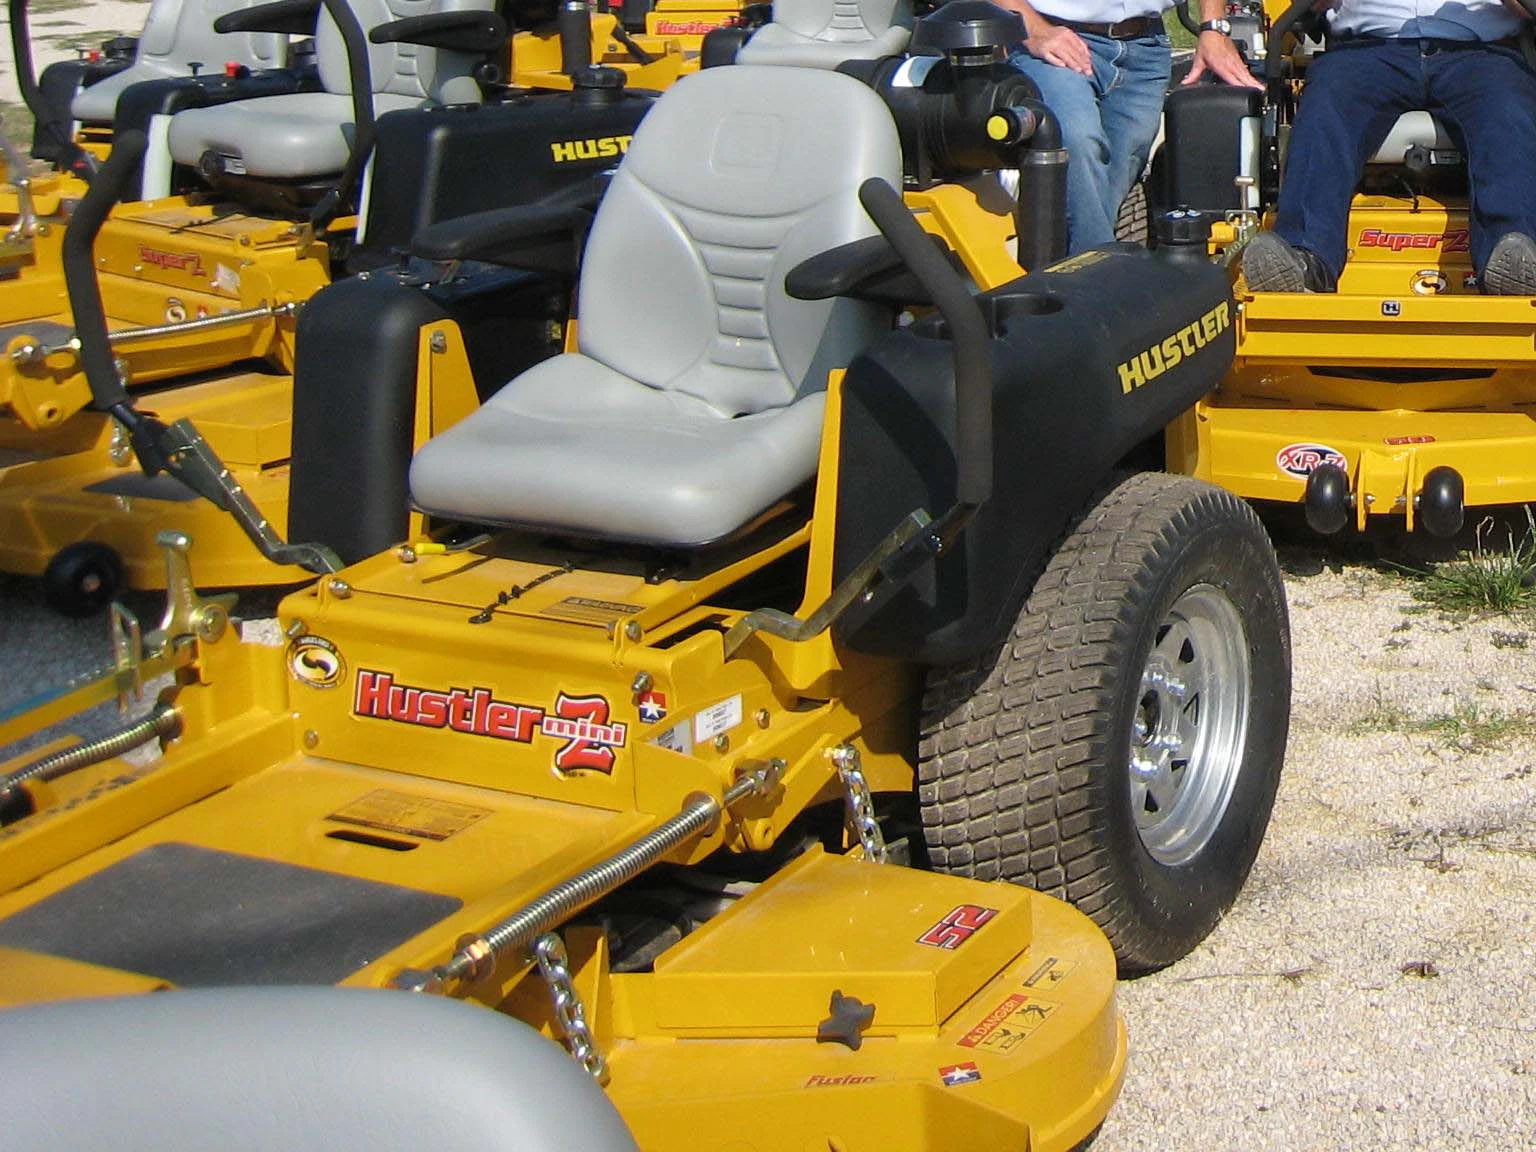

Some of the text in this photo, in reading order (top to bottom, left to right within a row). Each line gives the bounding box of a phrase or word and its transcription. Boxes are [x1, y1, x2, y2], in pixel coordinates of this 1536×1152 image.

[551, 135, 633, 162] HUST
[1117, 301, 1230, 395] HUSTLER
[354, 668, 546, 744] Hustler
[541, 715, 627, 748] mini
[915, 904, 1000, 950] 52
